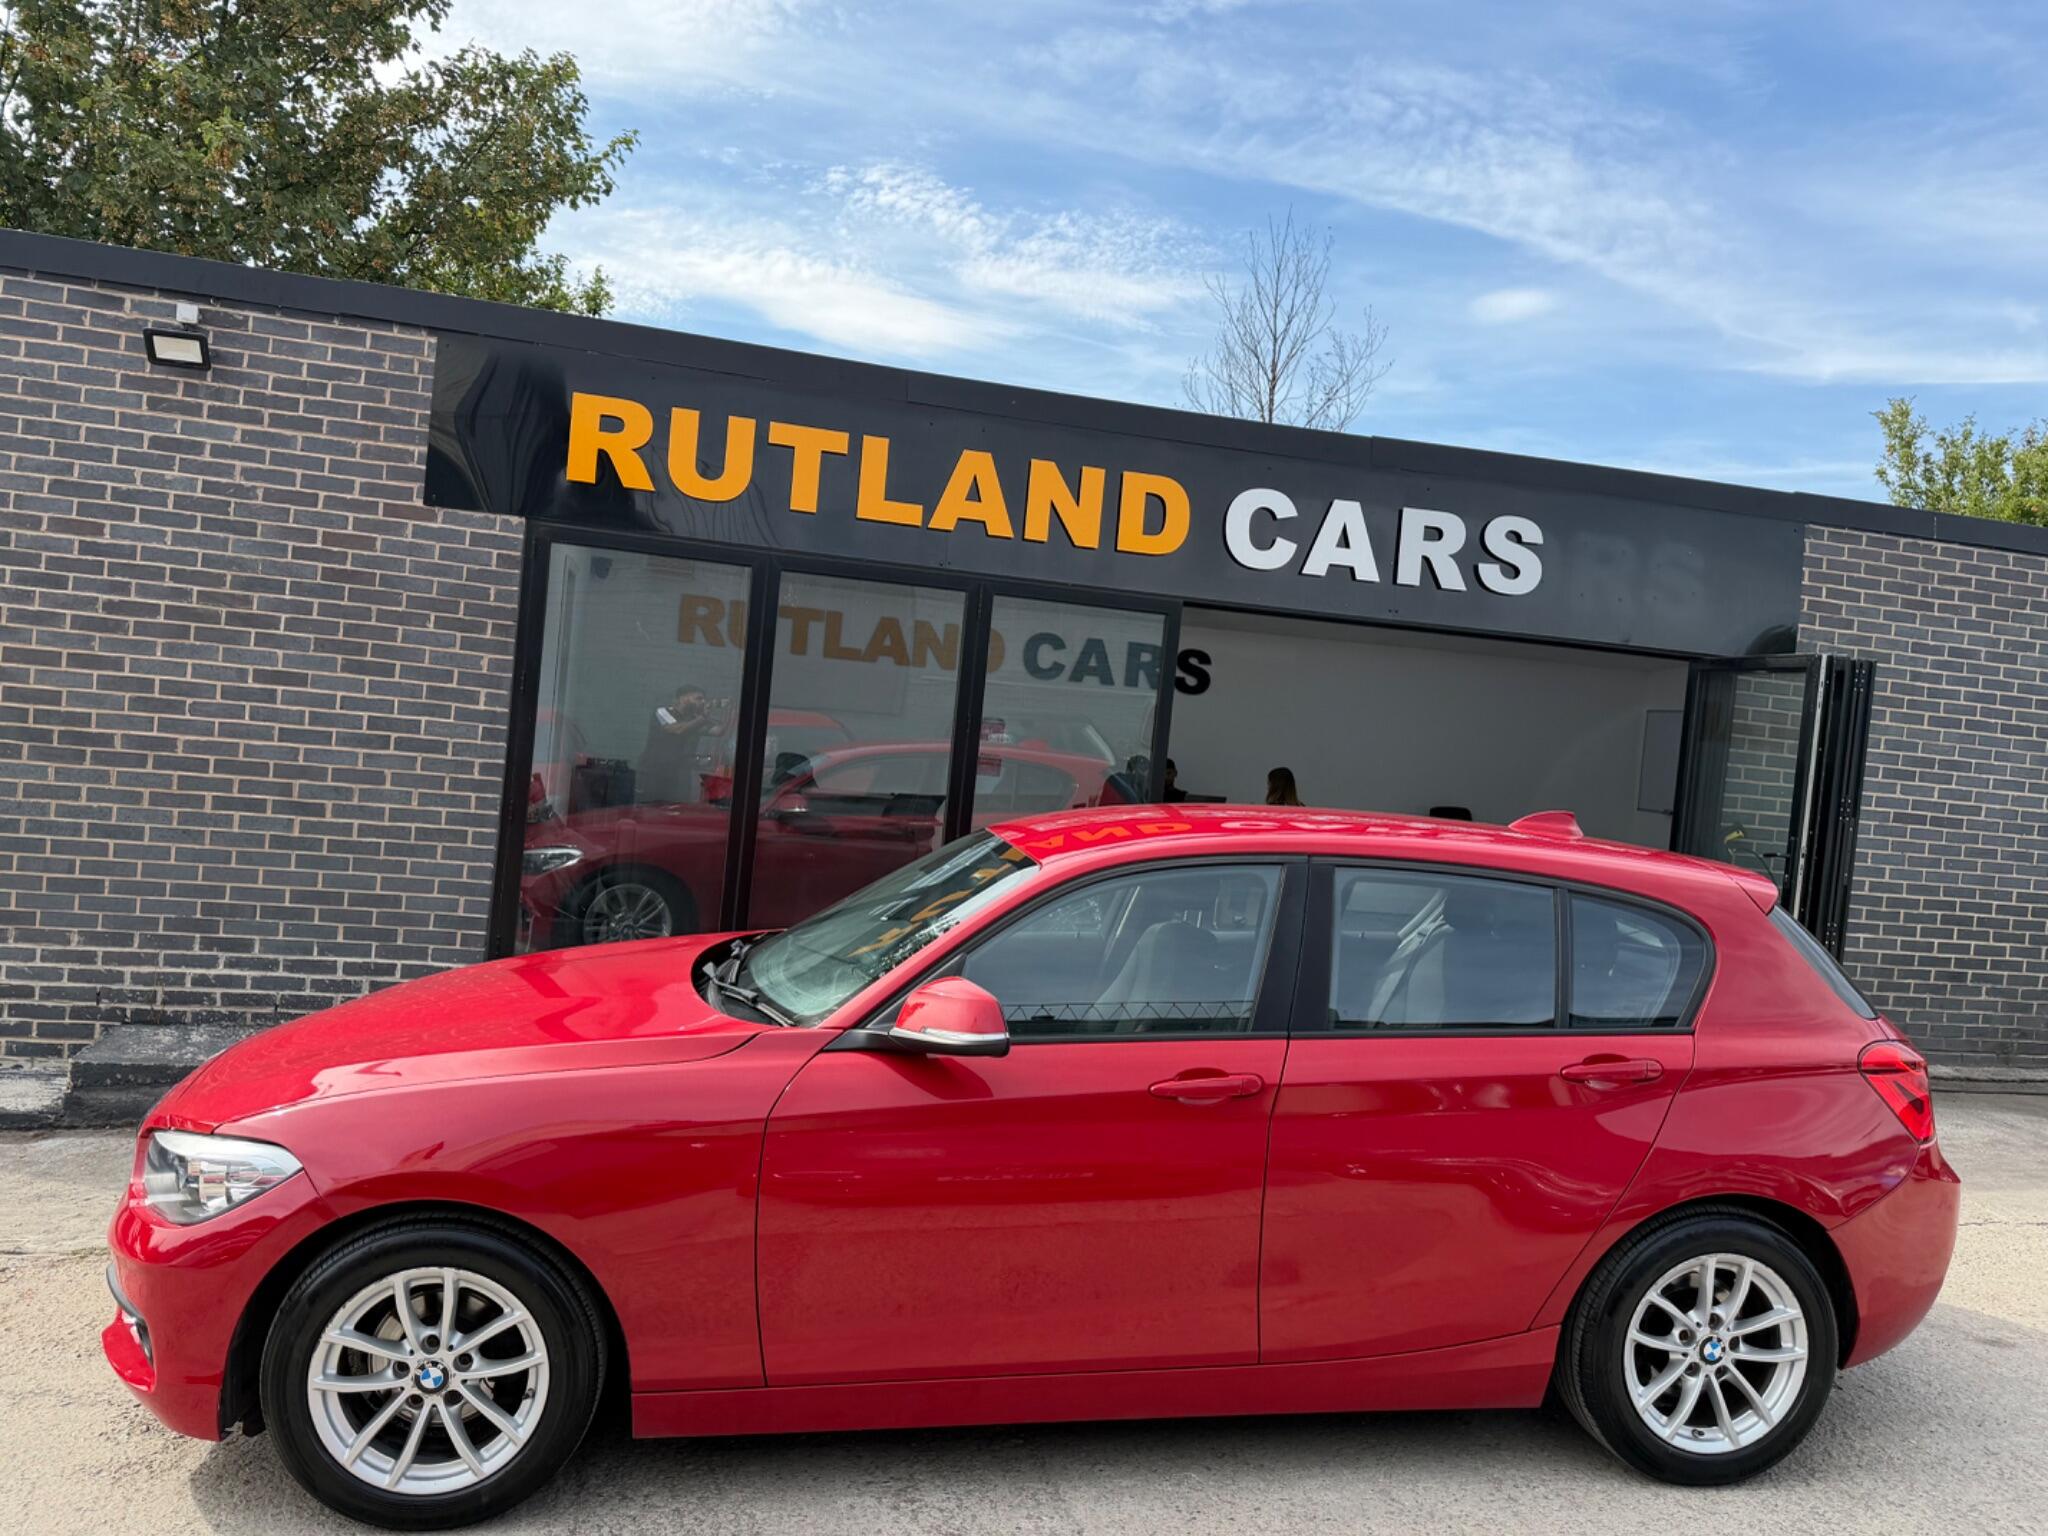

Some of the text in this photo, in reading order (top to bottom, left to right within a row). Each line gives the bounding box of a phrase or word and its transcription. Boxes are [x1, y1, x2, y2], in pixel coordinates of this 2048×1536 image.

[565, 391, 1544, 595] RUTLAND CARS
[1022, 631, 1213, 696] CARS
